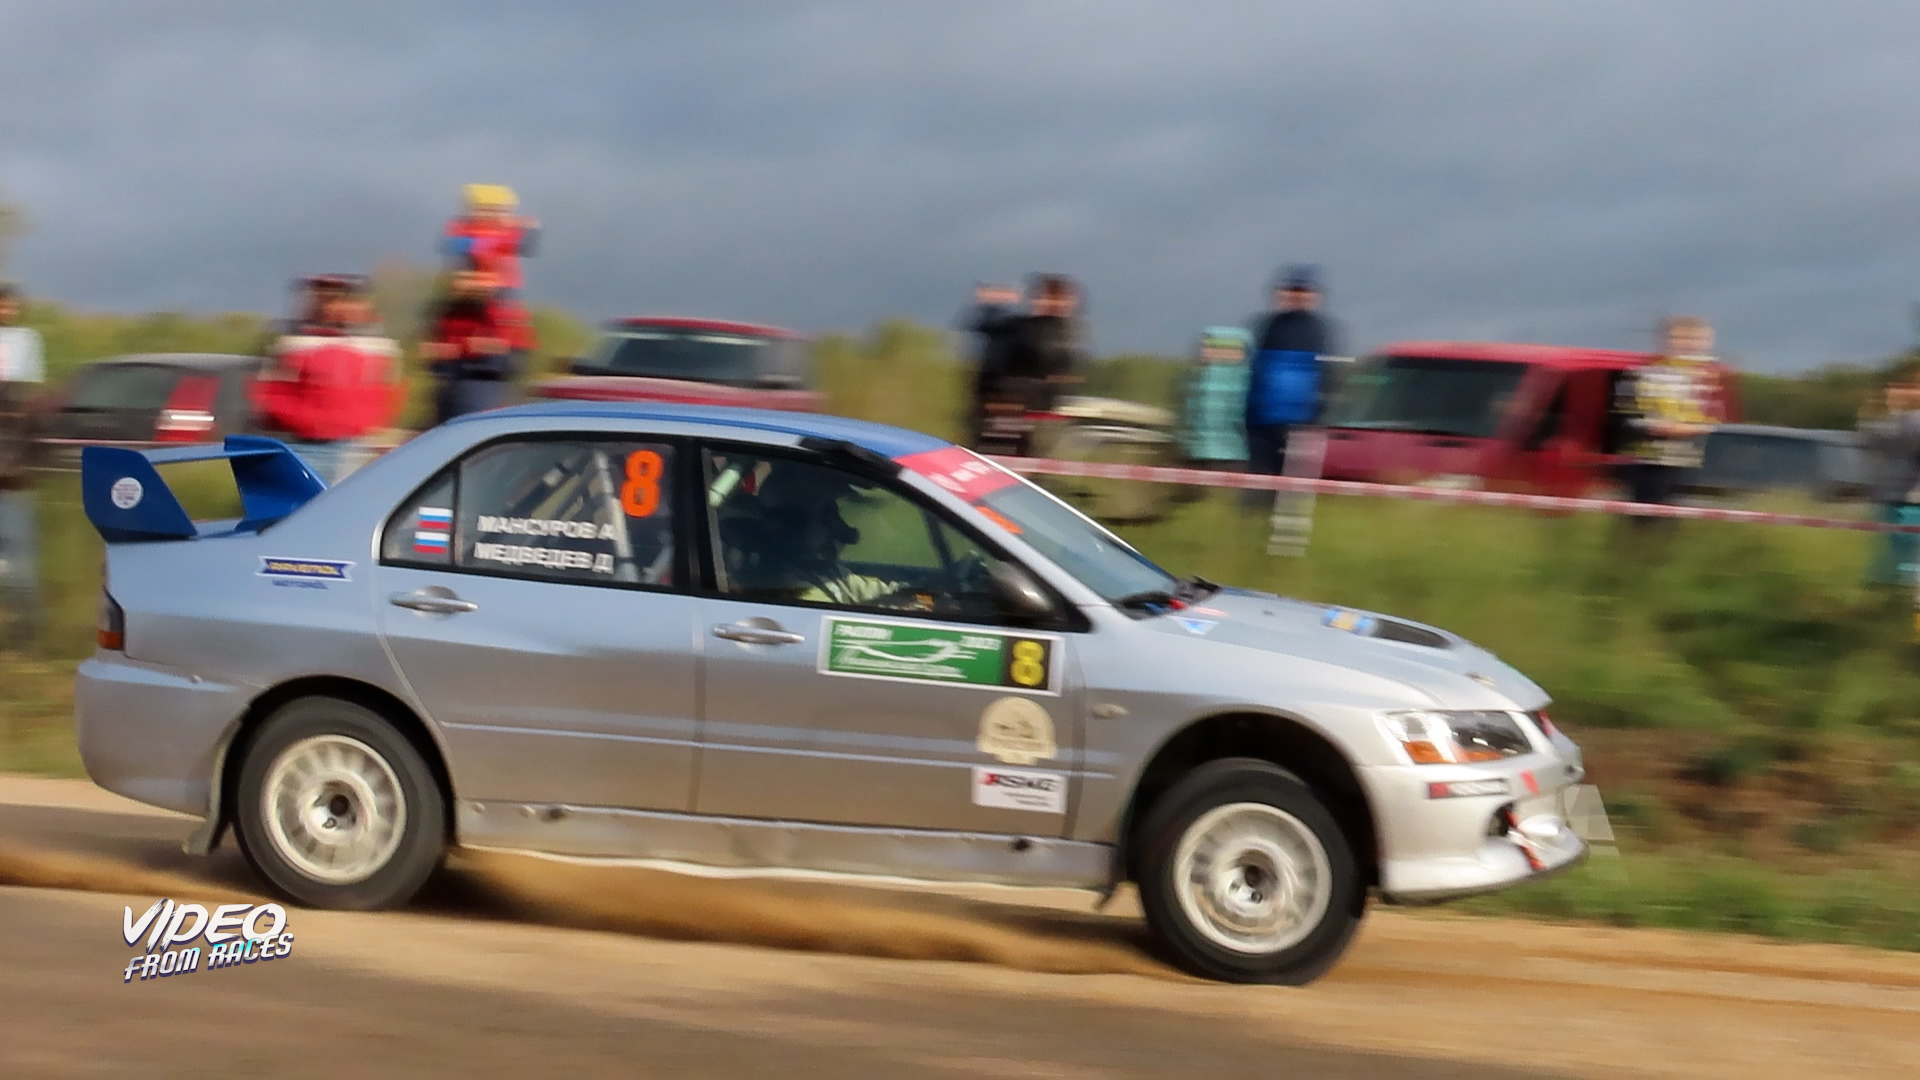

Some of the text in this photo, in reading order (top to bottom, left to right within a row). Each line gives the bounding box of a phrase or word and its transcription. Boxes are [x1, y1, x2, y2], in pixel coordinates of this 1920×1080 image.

[621, 450, 663, 517] 8
[477, 515, 598, 539] МАНСУРОВ
[474, 542, 593, 569] МЕДВЕДЕВ
[1010, 640, 1044, 686] 8
